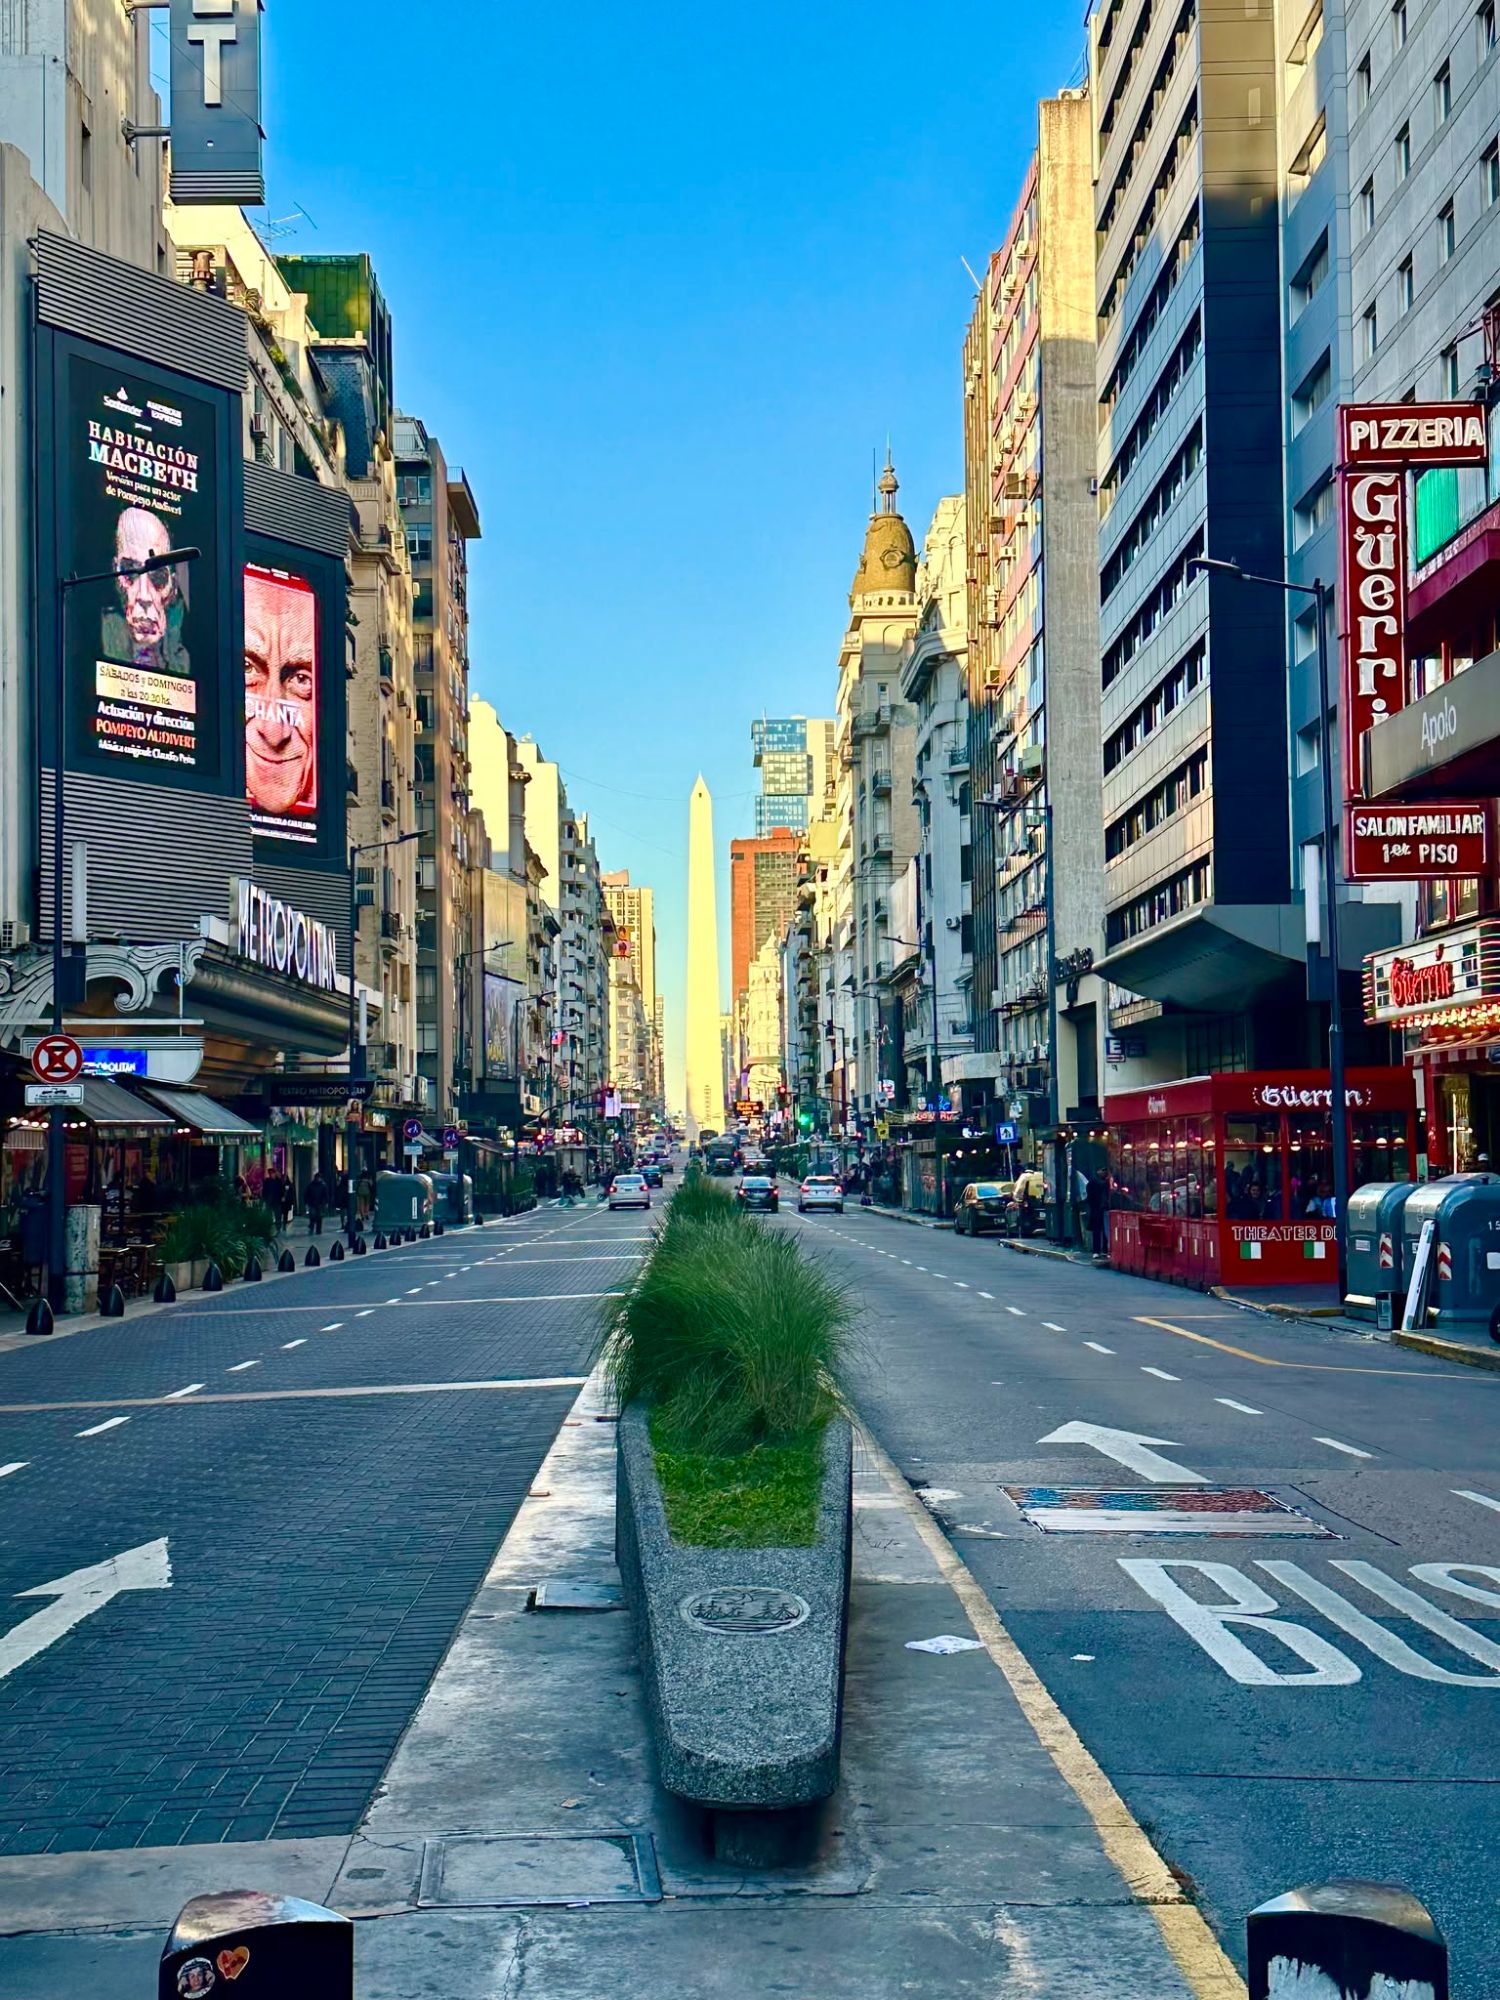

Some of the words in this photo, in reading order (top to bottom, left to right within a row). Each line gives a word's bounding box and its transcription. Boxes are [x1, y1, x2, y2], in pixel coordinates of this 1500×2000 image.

[88, 420, 198, 469] HABITACIÓN
[1350, 417, 1485, 451] PIZZERIA
[88, 440, 198, 493] MACBETH
[106, 485, 116, 496] de
[134, 481, 150, 493] para
[1352, 475, 1398, 727] Güerri
[147, 677, 193, 694] DOMINGOS
[97, 701, 145, 721] Actuación
[145, 713, 152, 726] y
[153, 710, 195, 731] dirección
[1421, 696, 1457, 757] Apolo
[96, 718, 146, 740] POMPEYO
[147, 729, 196, 749] AUDIVERT
[1355, 815, 1407, 837] SALON
[1408, 814, 1484, 836] FAMILIAR
[1418, 844, 1458, 864] PISO
[238, 880, 336, 992] METROPOLITAN
[1261, 1086, 1363, 1107] Güerrn
[1231, 1225, 1317, 1242] THEATER
[1320, 1225, 1338, 1242] D
